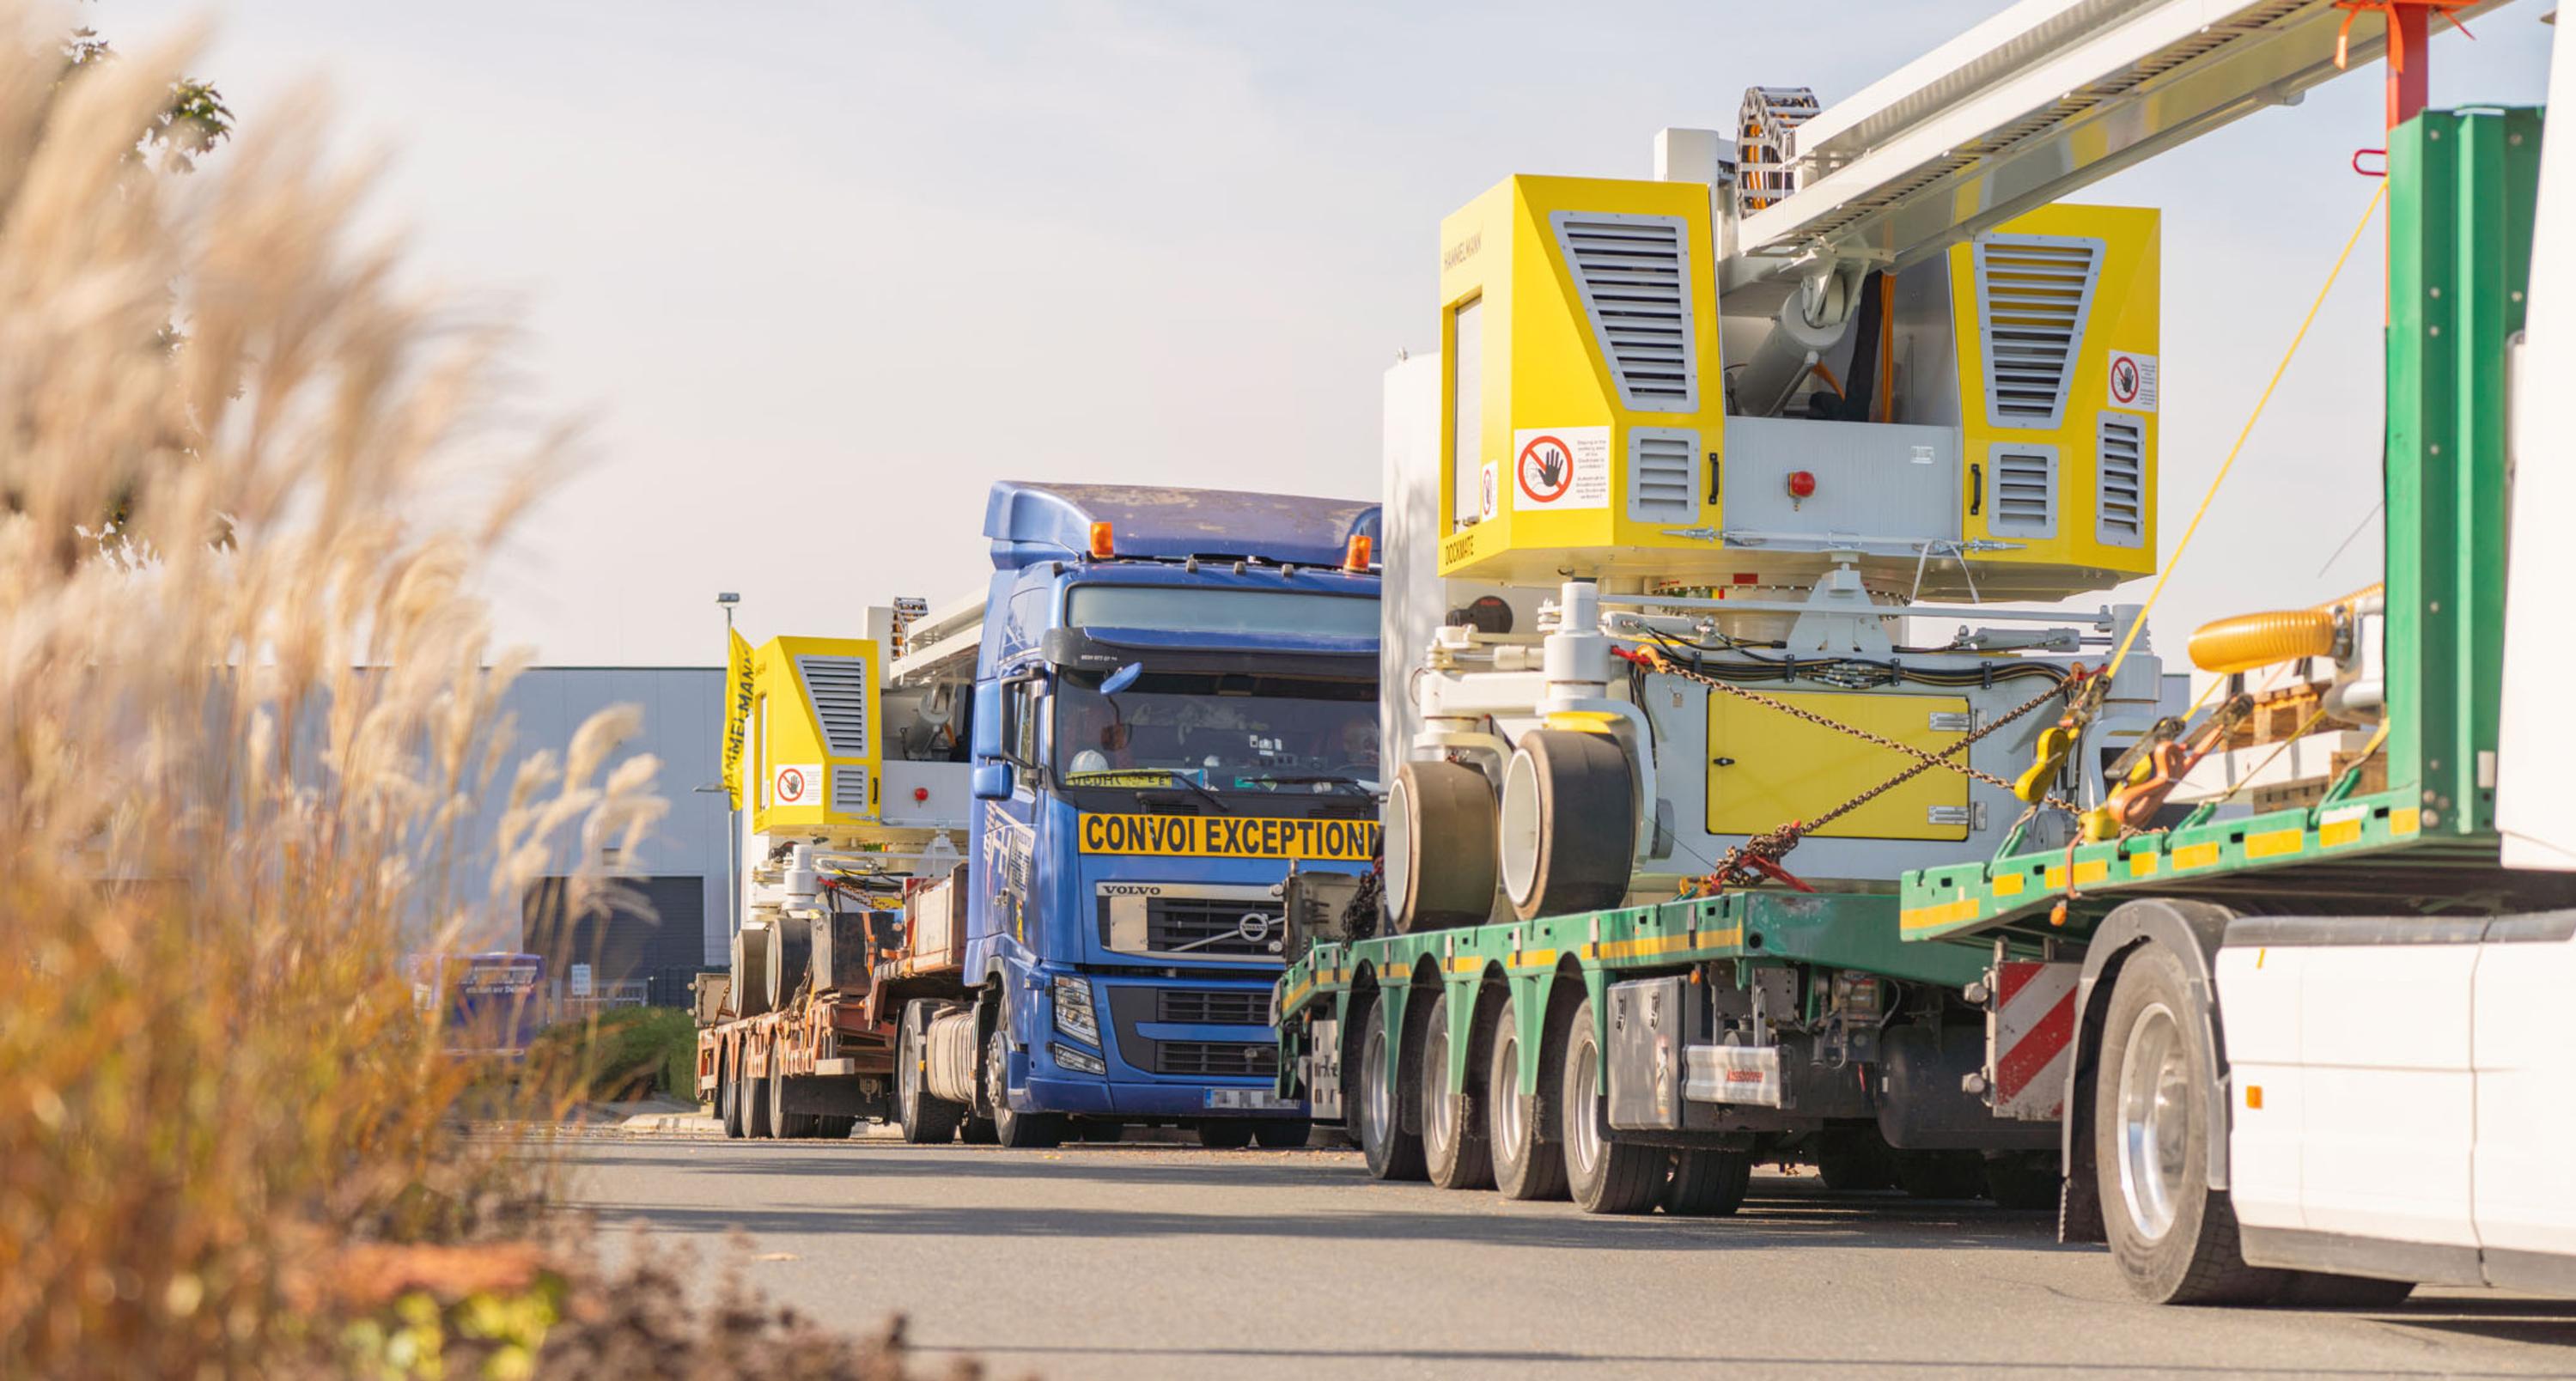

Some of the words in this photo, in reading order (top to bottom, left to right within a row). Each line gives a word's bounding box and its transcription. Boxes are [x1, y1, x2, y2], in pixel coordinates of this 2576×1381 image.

[1445, 534, 1474, 565] DOCKMATE
[1086, 815, 1195, 851] CONVOI
[1102, 885, 1160, 895] VOLVO
